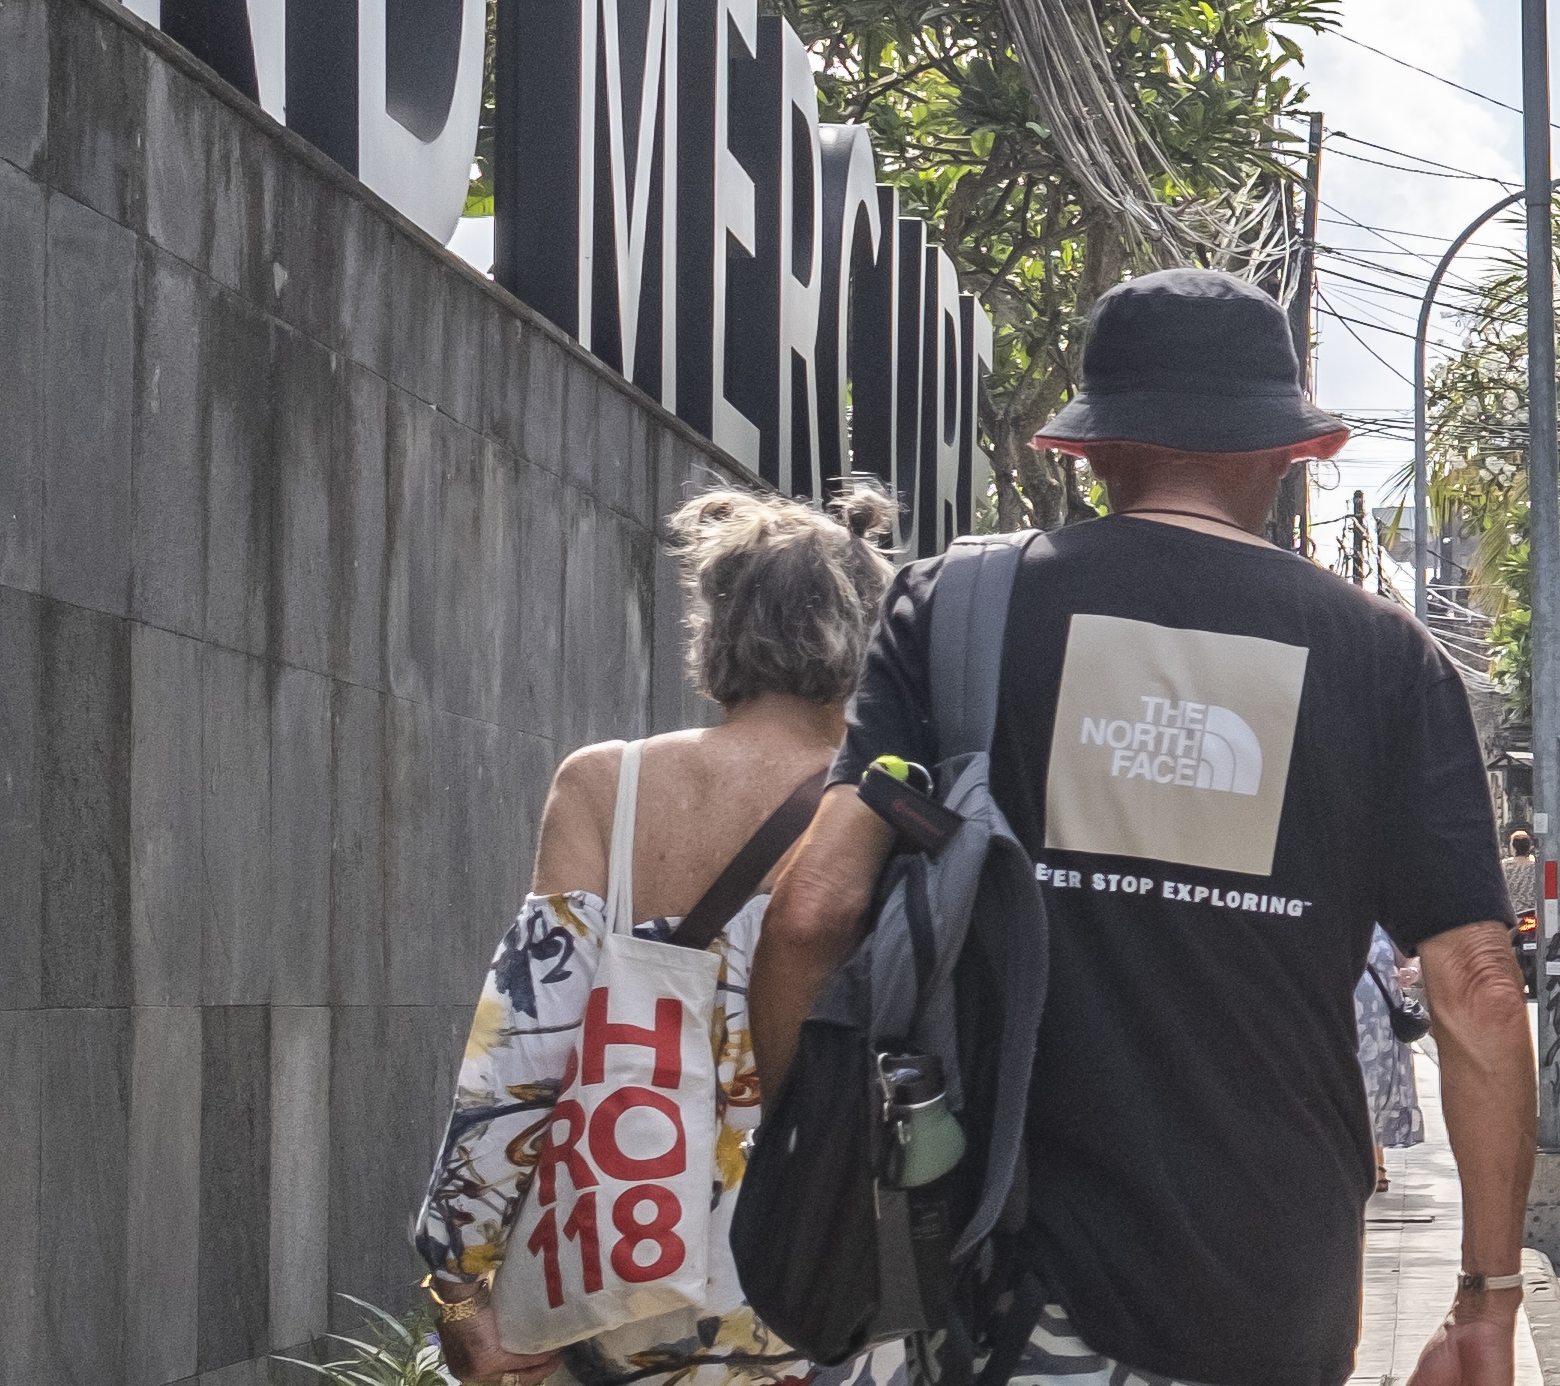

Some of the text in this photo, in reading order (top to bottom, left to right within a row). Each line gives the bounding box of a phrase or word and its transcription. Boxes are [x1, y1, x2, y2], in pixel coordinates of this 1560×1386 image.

[1140, 695, 1207, 731] THE
[1080, 717, 1202, 759] NORTH
[1111, 749, 1200, 787] FACE
[1092, 873, 1154, 895] STOP
[556, 985, 683, 1103] H
[527, 1183, 687, 1309] 118
